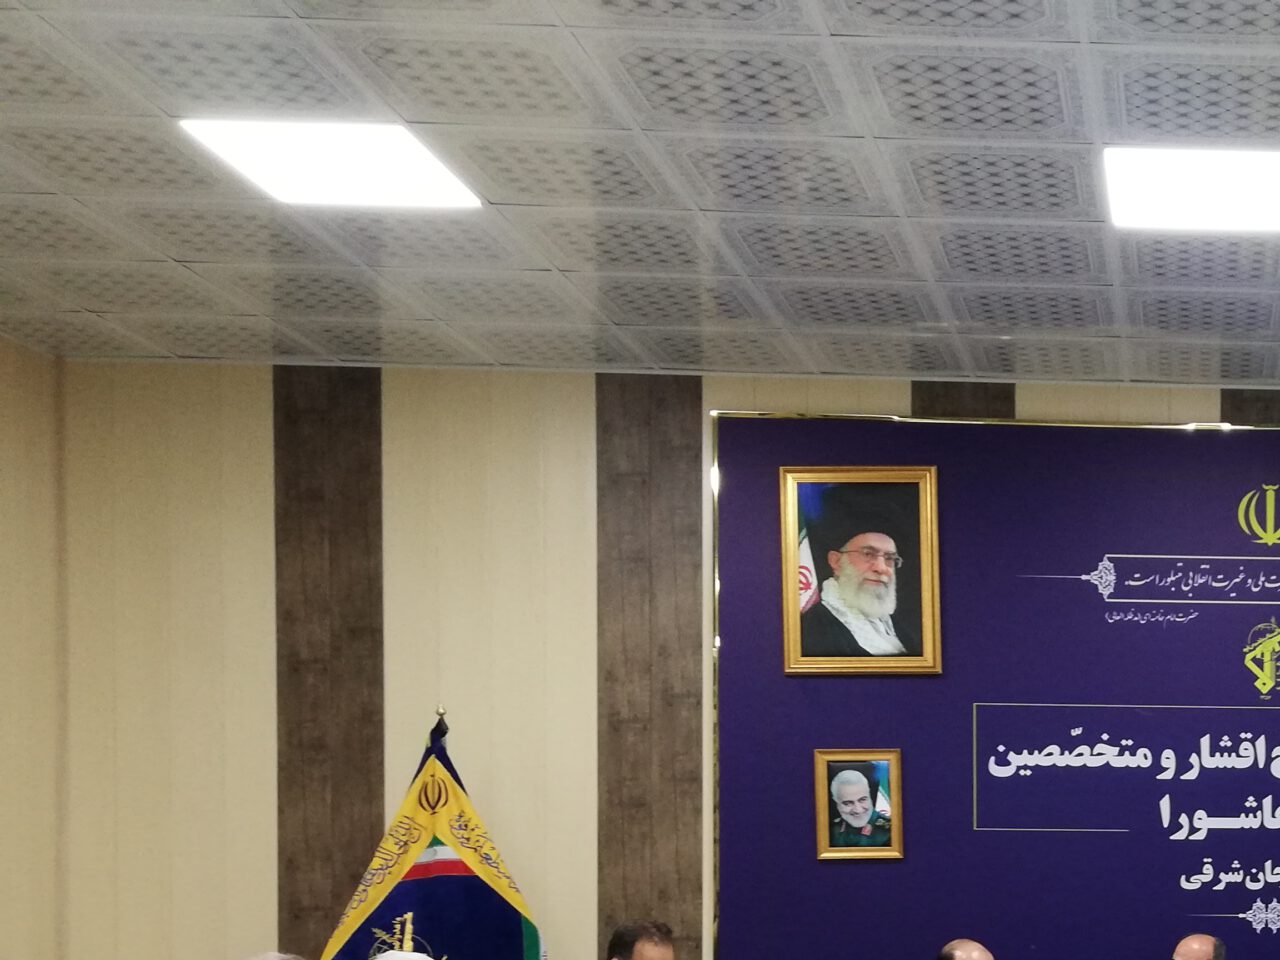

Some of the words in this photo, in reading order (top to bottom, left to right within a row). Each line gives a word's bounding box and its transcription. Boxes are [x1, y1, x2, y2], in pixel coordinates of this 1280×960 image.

[1181, 564, 1212, 597] انقلابی
[1211, 566, 1246, 597] غیرت
[1250, 571, 1266, 592] ملی
[1155, 748, 1177, 780] و
[1179, 732, 1266, 780] اقشار
[1180, 857, 1244, 891] شرقی
